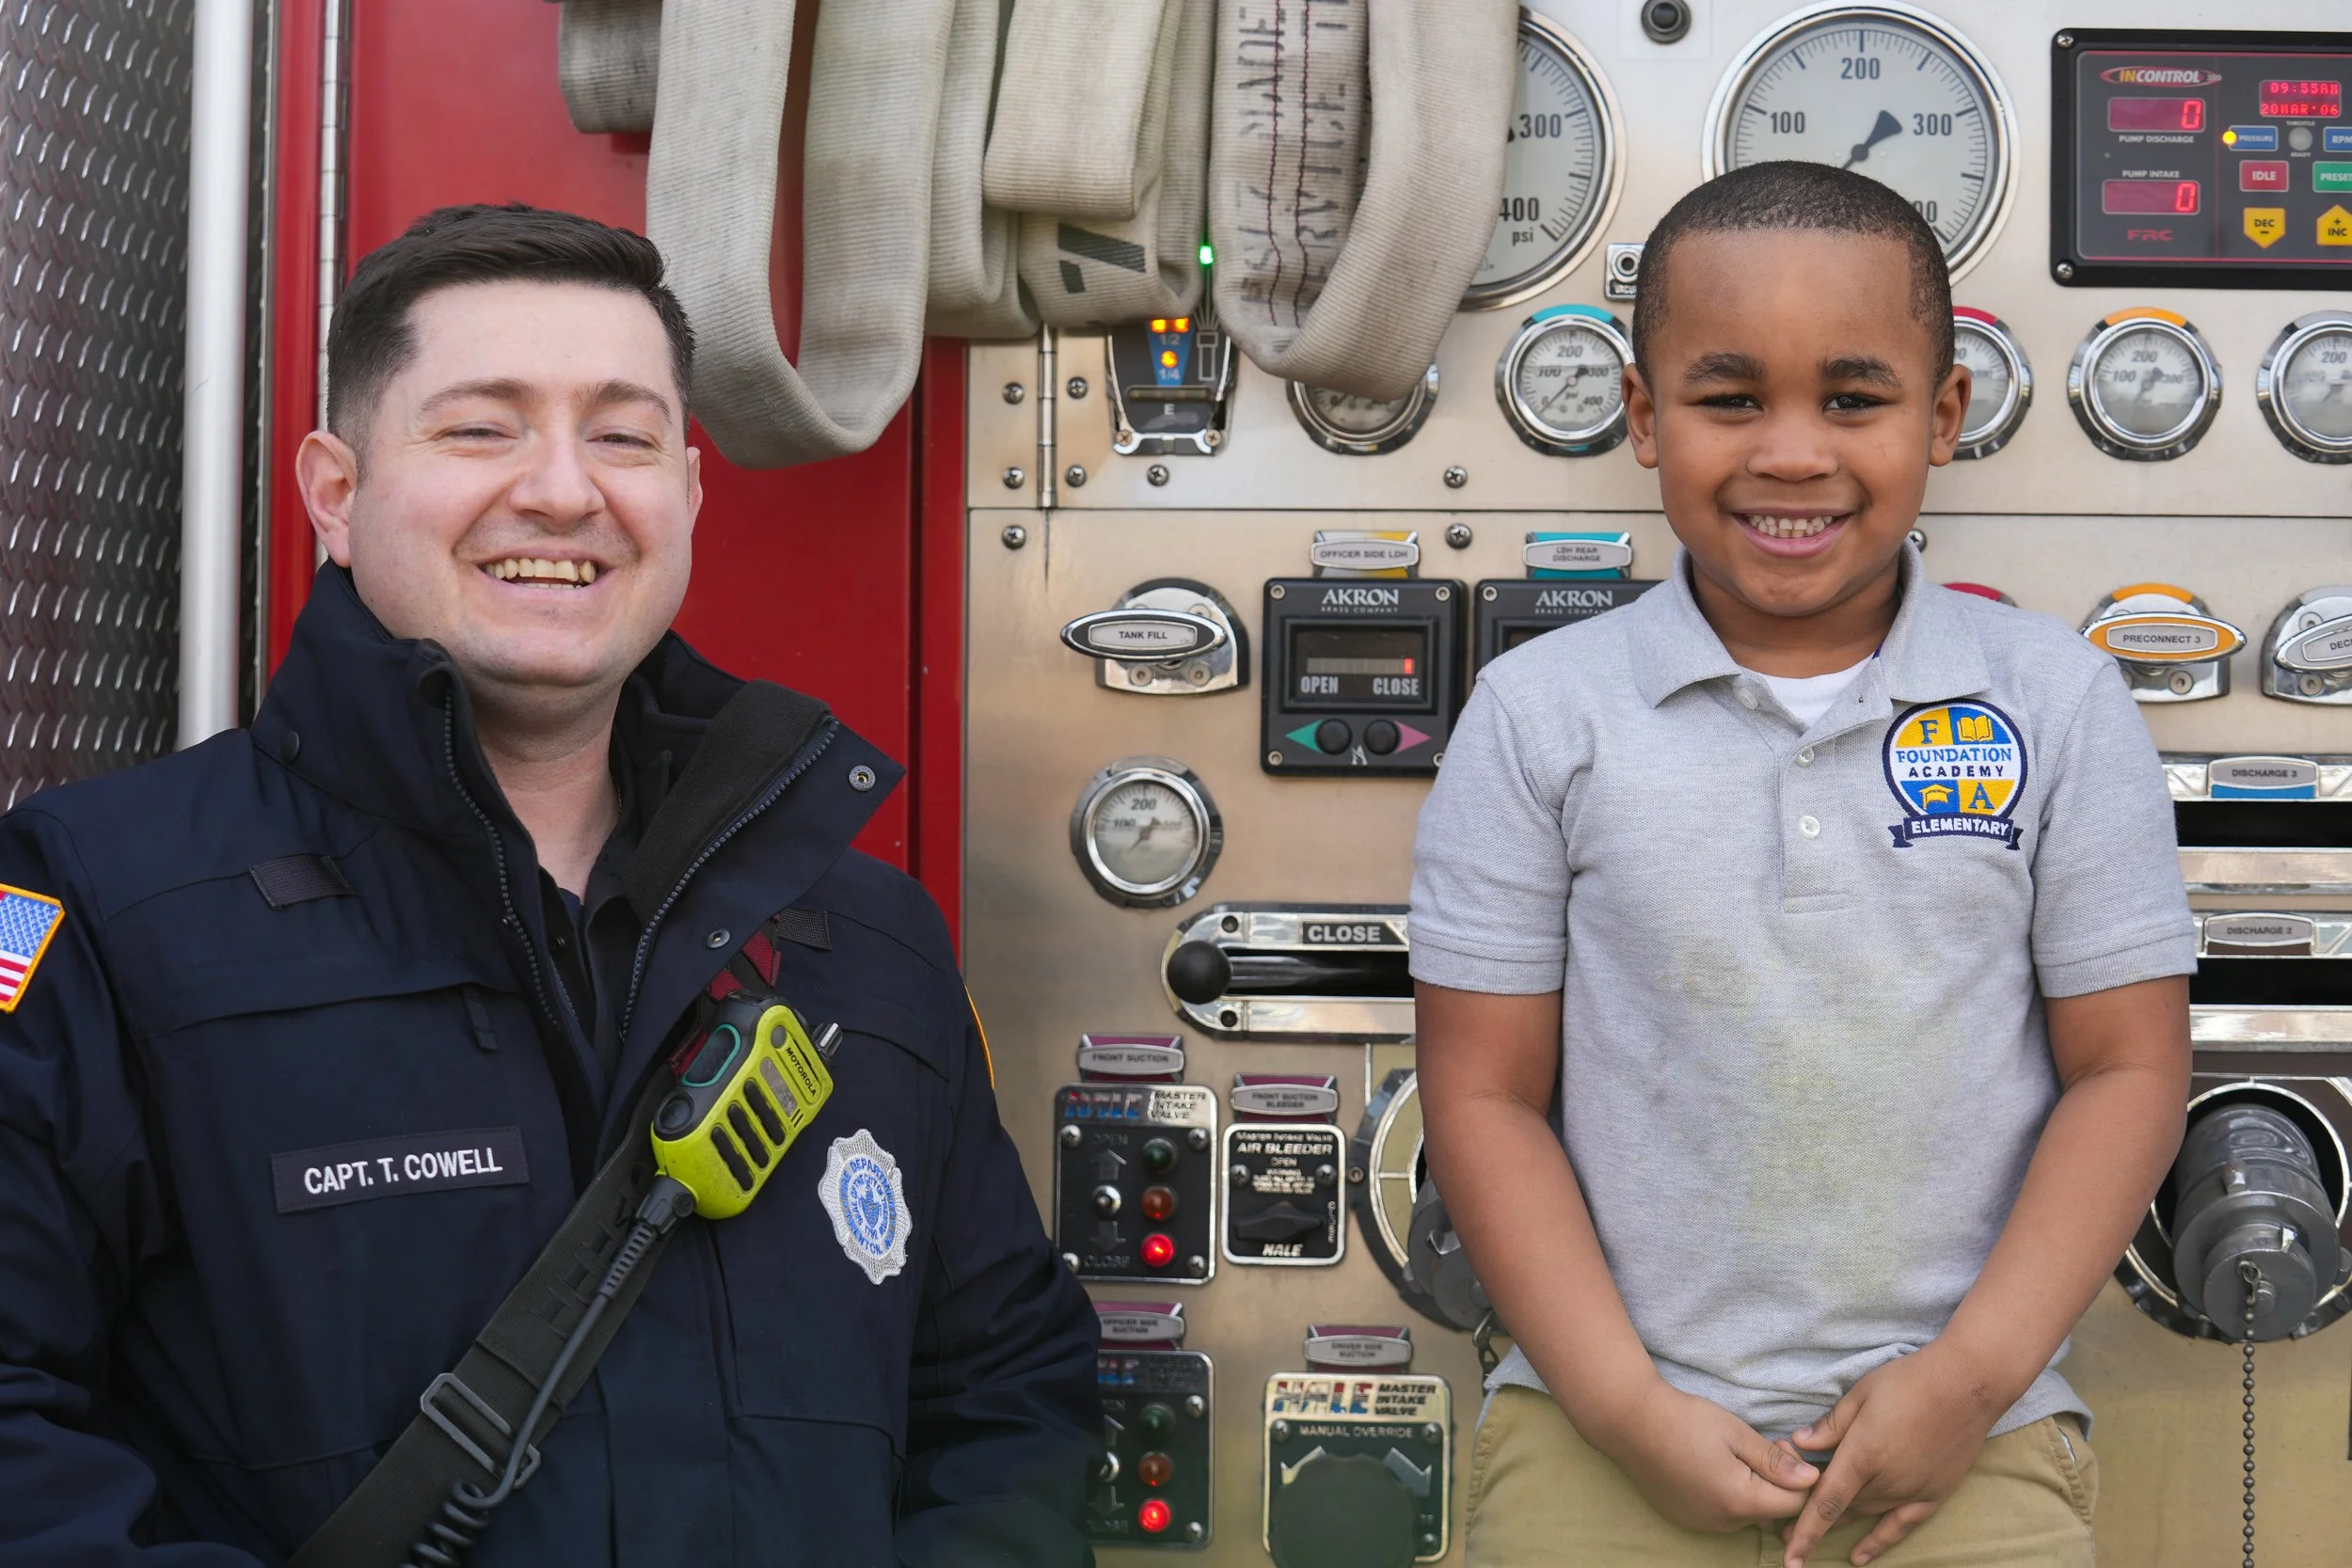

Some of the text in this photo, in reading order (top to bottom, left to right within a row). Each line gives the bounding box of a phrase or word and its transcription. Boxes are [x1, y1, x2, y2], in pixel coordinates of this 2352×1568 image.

[1840, 57, 1881, 80] 200
[2118, 70, 2201, 83] INCONTROL
[2180, 100, 2202, 130] 0
[1518, 114, 1562, 138] 300
[1770, 111, 1805, 134] 100
[1913, 113, 1952, 135] 300
[2119, 135, 2194, 144] PUMP DISCHARGE
[2122, 170, 2180, 179] PUMP INTAKE
[2251, 170, 2277, 182] IDLE
[2175, 182, 2197, 213] 0
[2253, 219, 2276, 228] DEC
[1512, 229, 1534, 246] psi
[2127, 230, 2175, 242] FRC
[2328, 228, 2348, 236] INC
[1158, 334, 1182, 345] 1/2
[1556, 345, 1584, 358] 200
[2131, 350, 2158, 364] 200
[2320, 351, 2347, 364] 200
[1158, 368, 1181, 381] 1/4
[1163, 404, 1175, 416] E
[1319, 549, 1361, 559] OFFICER
[1364, 550, 1386, 559] SIDE
[1321, 588, 1400, 606] AKRON
[1534, 590, 1613, 608] AKRON
[1119, 631, 1168, 640] TANK FILL
[2122, 634, 2201, 644] PRECONNECT 3
[1300, 675, 1340, 694] OPEN
[1372, 677, 1420, 695] CLOSE
[1918, 720, 1939, 745] F
[1895, 748, 2012, 764] FOUNDATION
[1908, 765, 2004, 778] ACADEMY
[2232, 768, 2288, 778] DISCHARGE
[1967, 782, 1995, 810] A
[1131, 797, 1158, 811] 200
[1910, 816, 2010, 836] ELEMENTARY
[1307, 925, 1381, 942] CLOSE
[2226, 926, 2293, 935] DISCHARGE 2
[1091, 1053, 1169, 1063] FRONT SUCTION
[786, 1046, 817, 1098] MOTOROLA
[1153, 1091, 1207, 1101] MASTER
[1251, 1092, 1319, 1101] FRONT SUCTION
[1153, 1101, 1198, 1111] INTAKE
[1150, 1112, 1191, 1120] VALVE
[1235, 1132, 1273, 1141] MASTER
[1236, 1142, 1334, 1156] AIR BLEEDER
[1270, 1157, 1298, 1167] OPEN
[304, 1147, 503, 1196] CAPT. T. COWELL
[1262, 1243, 1305, 1258] HALE
[1378, 1384, 1437, 1394] MASTER
[1376, 1395, 1426, 1404] INTAKE
[1375, 1406, 1418, 1416] VALVE
[1299, 1425, 1414, 1438] MANUAL OVERRIDE
